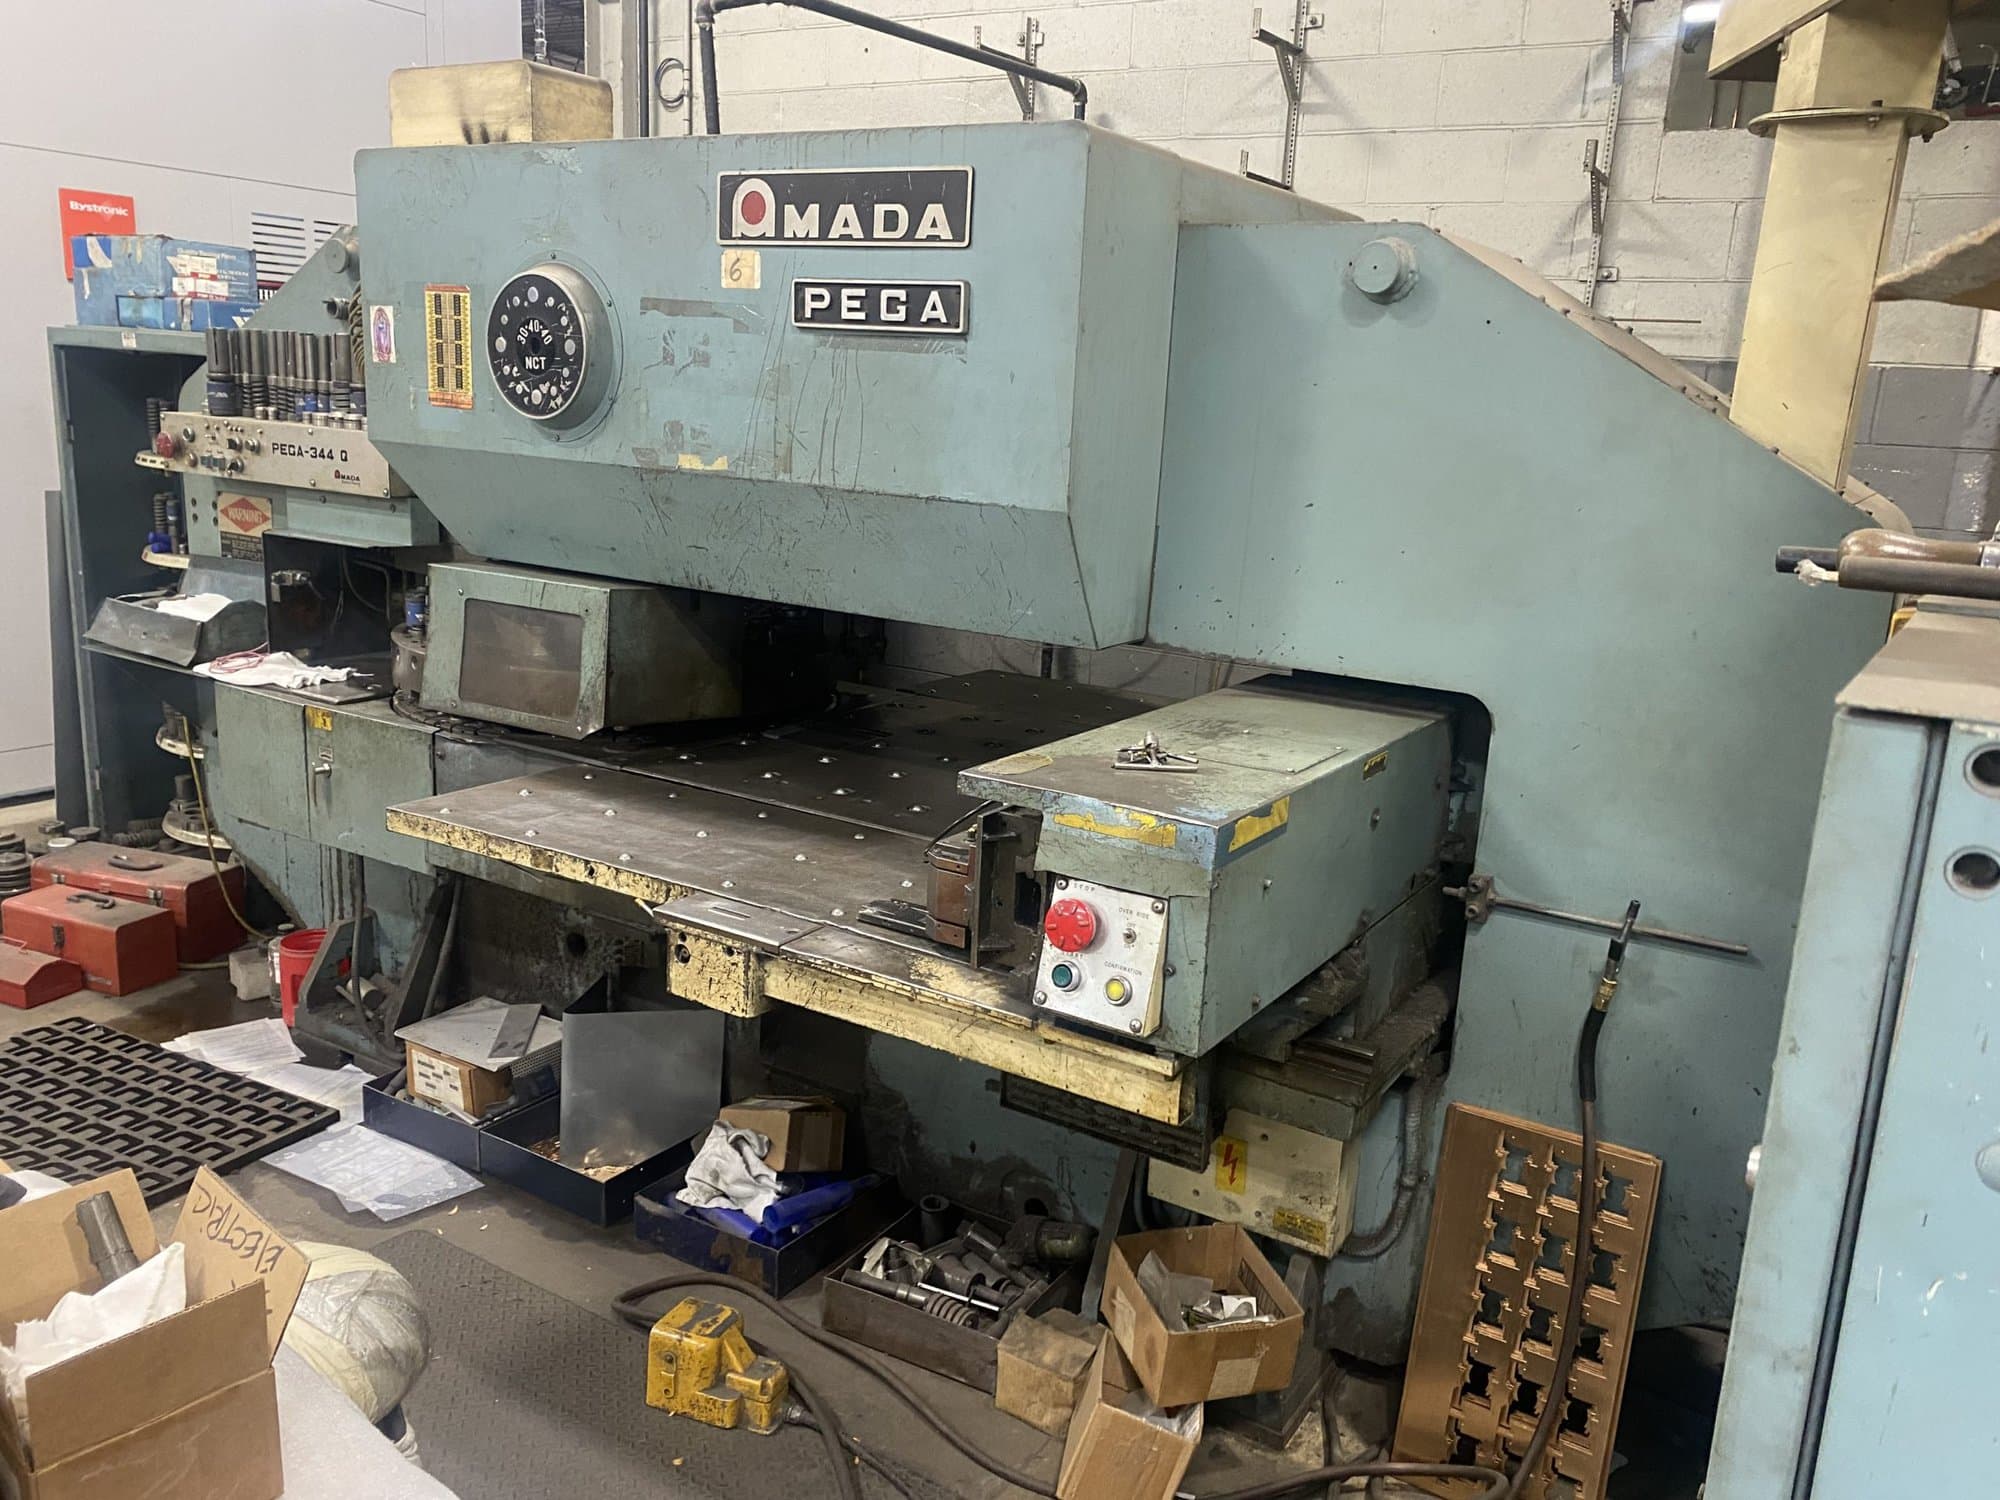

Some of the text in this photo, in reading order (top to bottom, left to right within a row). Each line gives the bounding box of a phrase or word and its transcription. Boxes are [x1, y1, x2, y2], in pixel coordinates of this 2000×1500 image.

[69, 200, 129, 217] Bystronic
[732, 178, 954, 240] AMADA
[729, 257, 743, 282] 6
[803, 287, 948, 323] PEGA
[525, 356, 546, 370] NCT
[271, 442, 349, 462] PEGA-344 Q
[228, 507, 264, 524] WARNING
[1104, 960, 1143, 977] CONFIRMATION
